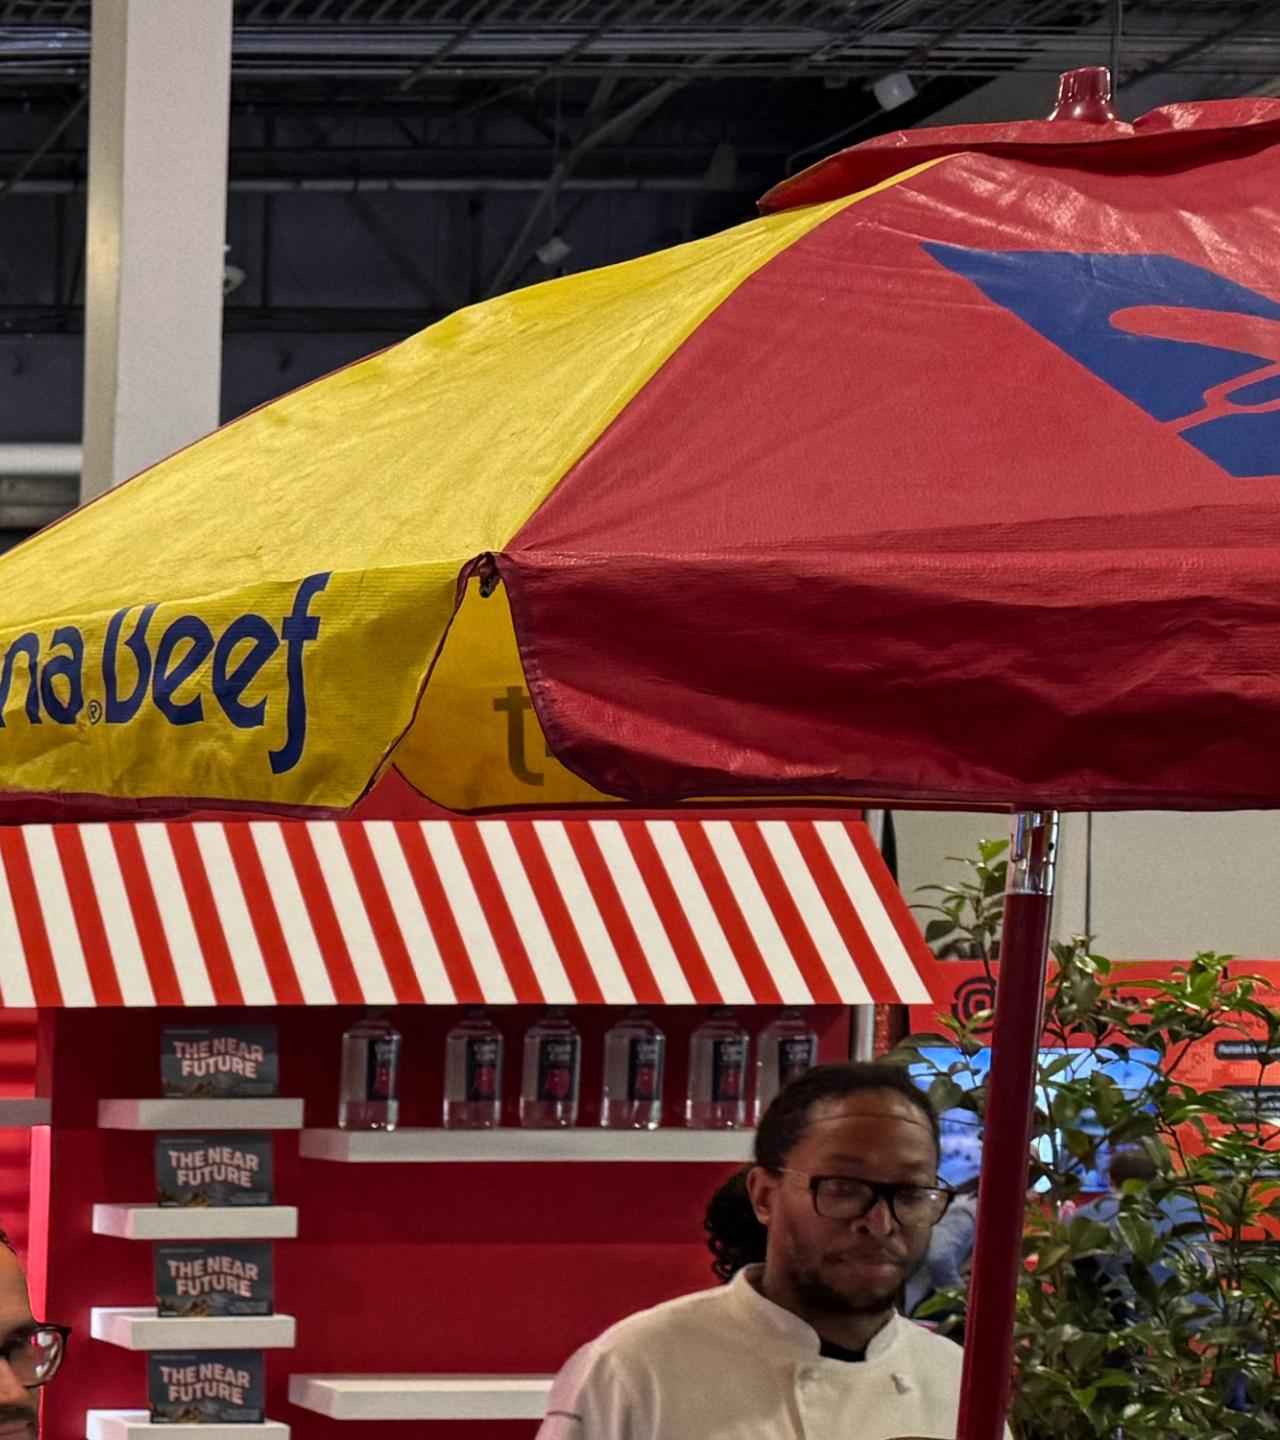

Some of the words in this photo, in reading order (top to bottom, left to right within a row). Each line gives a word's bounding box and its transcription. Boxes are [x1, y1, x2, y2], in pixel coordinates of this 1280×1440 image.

[101, 571, 334, 775] Beef
[173, 1041, 211, 1060] THE
[213, 1036, 265, 1062] NEAR
[181, 1055, 258, 1079] FUTURE
[168, 1149, 206, 1169] THE
[207, 1146, 260, 1171] NEAR
[177, 1165, 253, 1189] FUTURE
[167, 1258, 205, 1278] THE
[206, 1255, 259, 1280] NEAR
[176, 1274, 252, 1298] FUTURE
[160, 1366, 197, 1385] THE
[199, 1363, 251, 1388] NEAR
[168, 1381, 244, 1405] FUTURE
